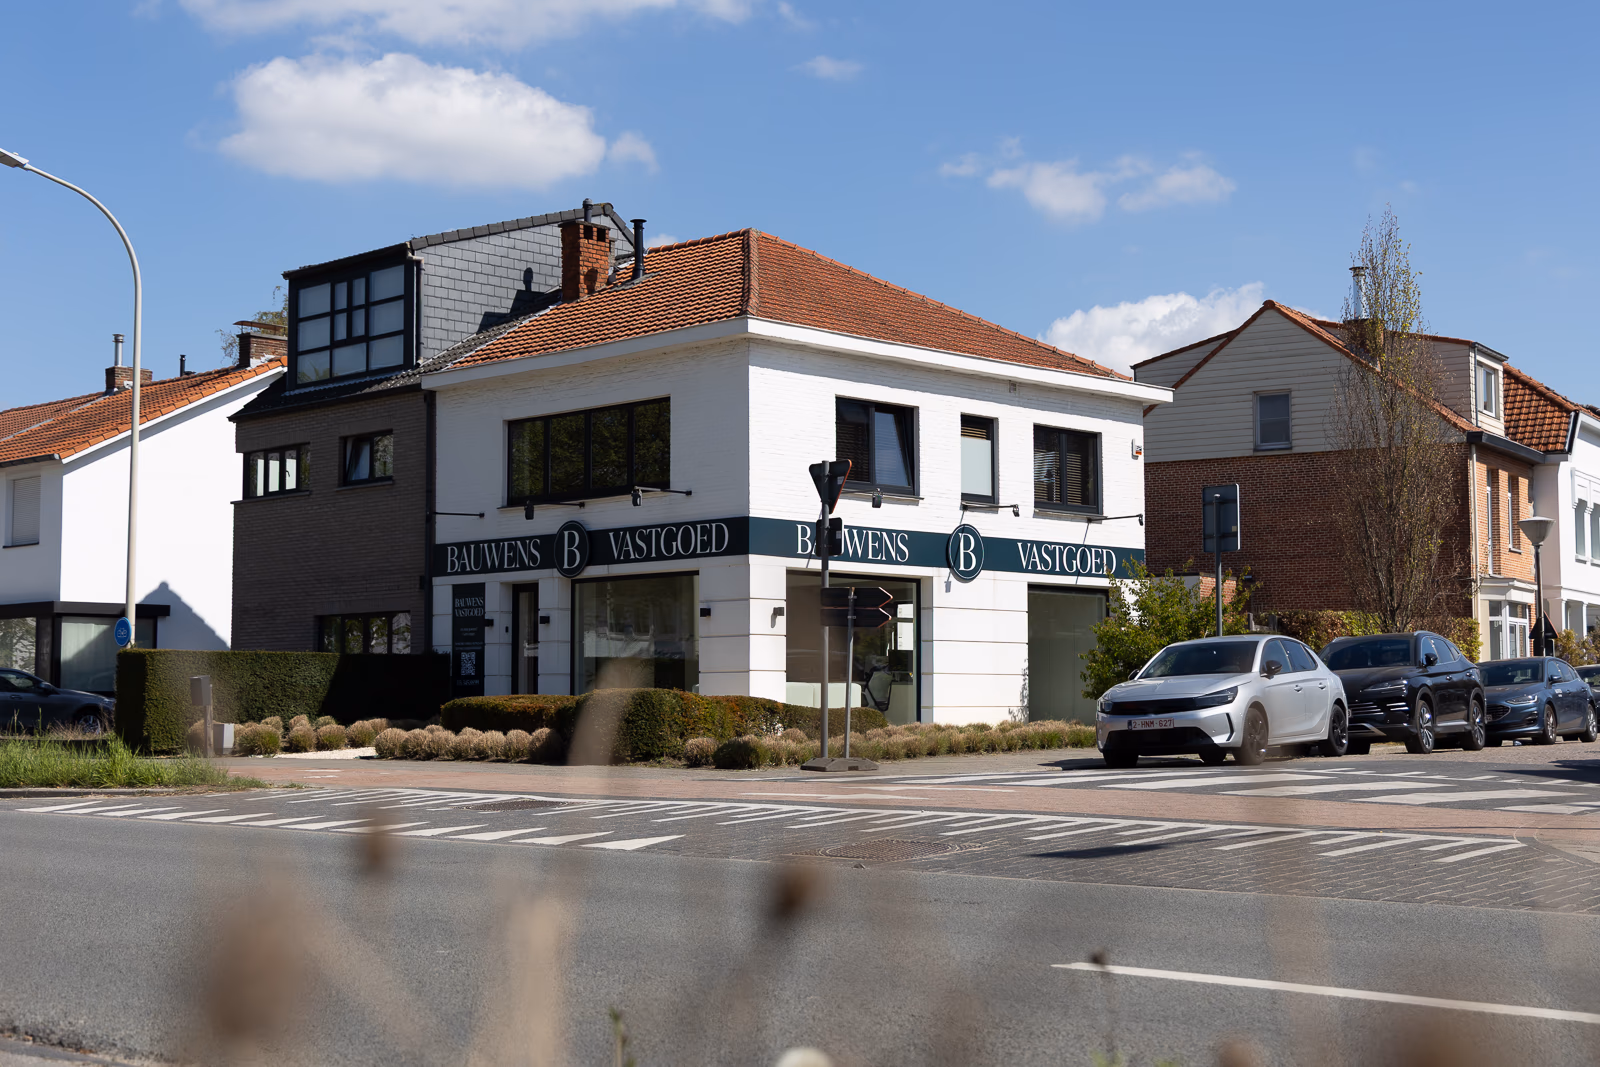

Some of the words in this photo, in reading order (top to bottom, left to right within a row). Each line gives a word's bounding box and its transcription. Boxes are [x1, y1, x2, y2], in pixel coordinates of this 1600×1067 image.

[446, 538, 541, 573] BAUWENS
[562, 530, 581, 569] B
[608, 522, 729, 560] VASTGOED
[796, 524, 909, 562] BWENS
[958, 532, 977, 571] B
[1017, 542, 1117, 575] VASTGOED
